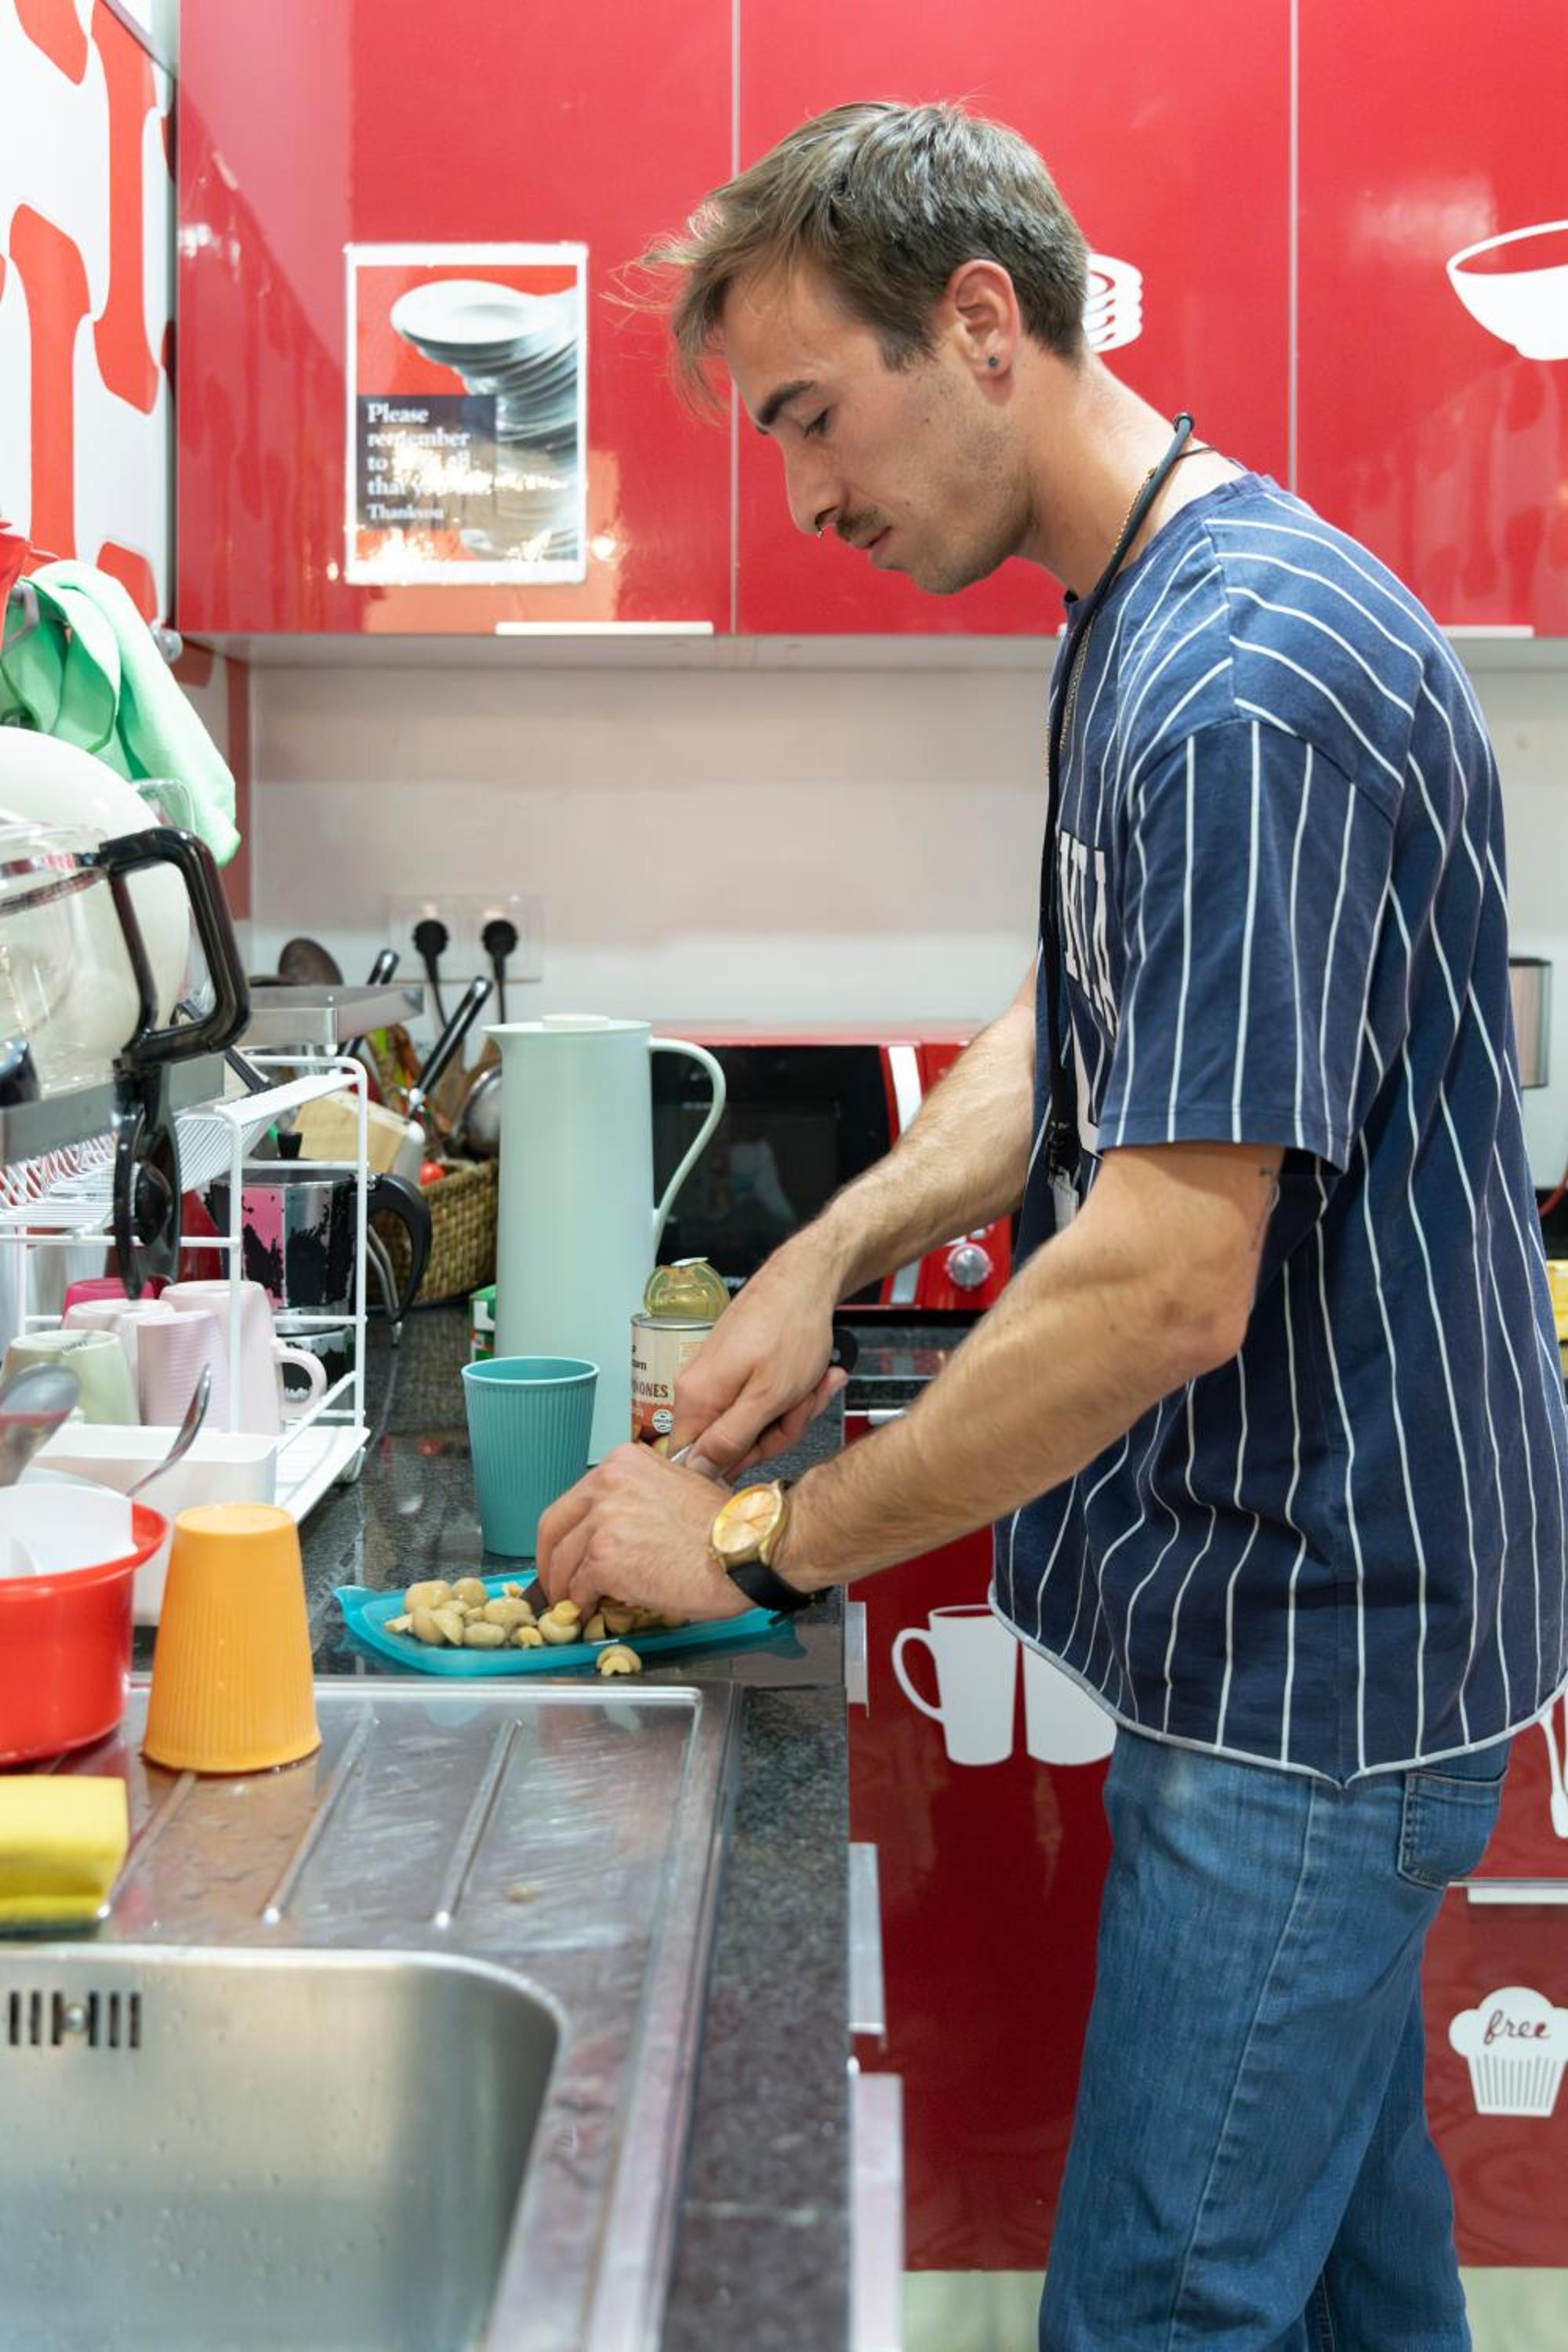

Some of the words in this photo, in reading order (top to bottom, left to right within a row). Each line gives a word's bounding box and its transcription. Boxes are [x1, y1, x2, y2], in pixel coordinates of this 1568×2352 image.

[367, 402, 429, 423] Please
[367, 456, 388, 472] to
[1483, 2009, 1551, 2045] free
